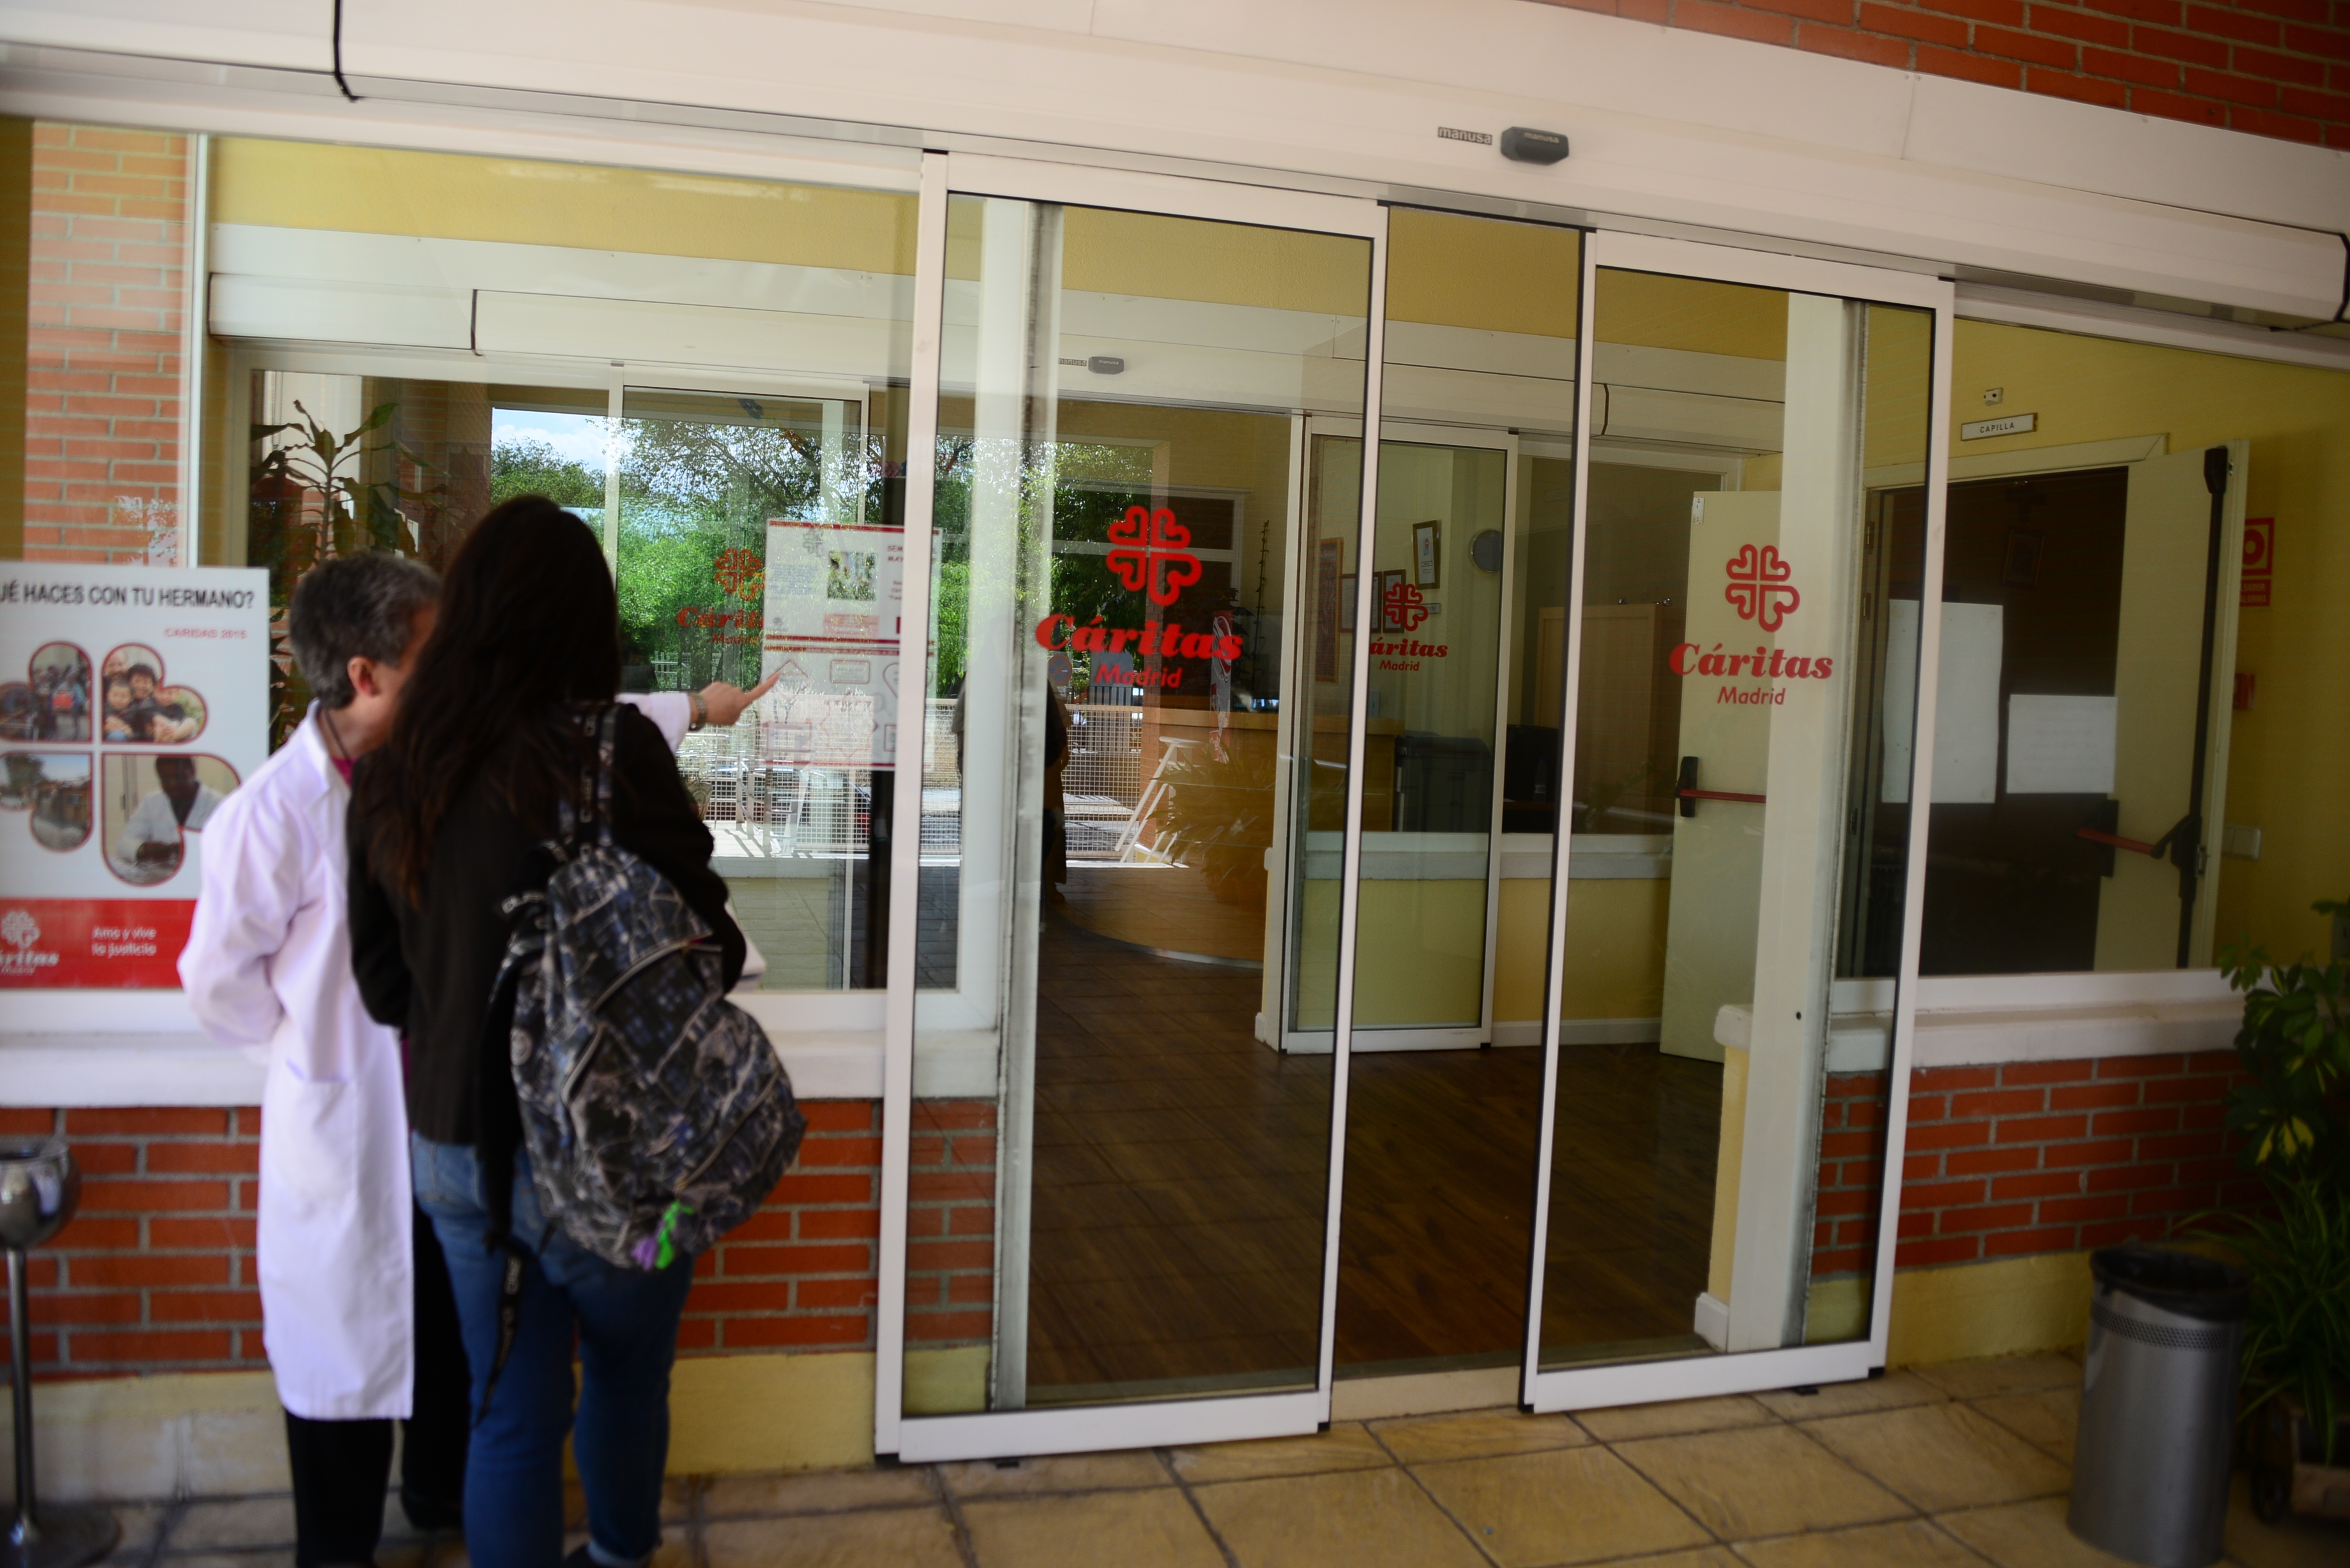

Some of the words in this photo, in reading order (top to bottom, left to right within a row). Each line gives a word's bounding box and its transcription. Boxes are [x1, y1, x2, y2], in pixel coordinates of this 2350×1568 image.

[1439, 128, 1491, 144] manusa
[1524, 132, 1559, 144] manusa
[1980, 422, 2015, 433] CAPILLA
[23, 584, 84, 604] HACES
[89, 585, 126, 605] CON
[132, 587, 155, 606] TU
[158, 589, 255, 608] HERMANO?
[165, 628, 217, 638] CARIDAD
[220, 629, 246, 639] 2015
[710, 633, 760, 645] Madrid
[1035, 614, 1243, 660] Cáritas
[1370, 637, 1448, 658] áritas
[1379, 660, 1420, 671] Madrid
[1669, 643, 1833, 679] Cáritas
[1095, 663, 1183, 688] Madrid
[1717, 686, 1786, 705] Madrid
[93, 928, 121, 940] Ama
[121, 930, 130, 942] y
[131, 928, 157, 940] vive
[107, 944, 157, 958] justicia
